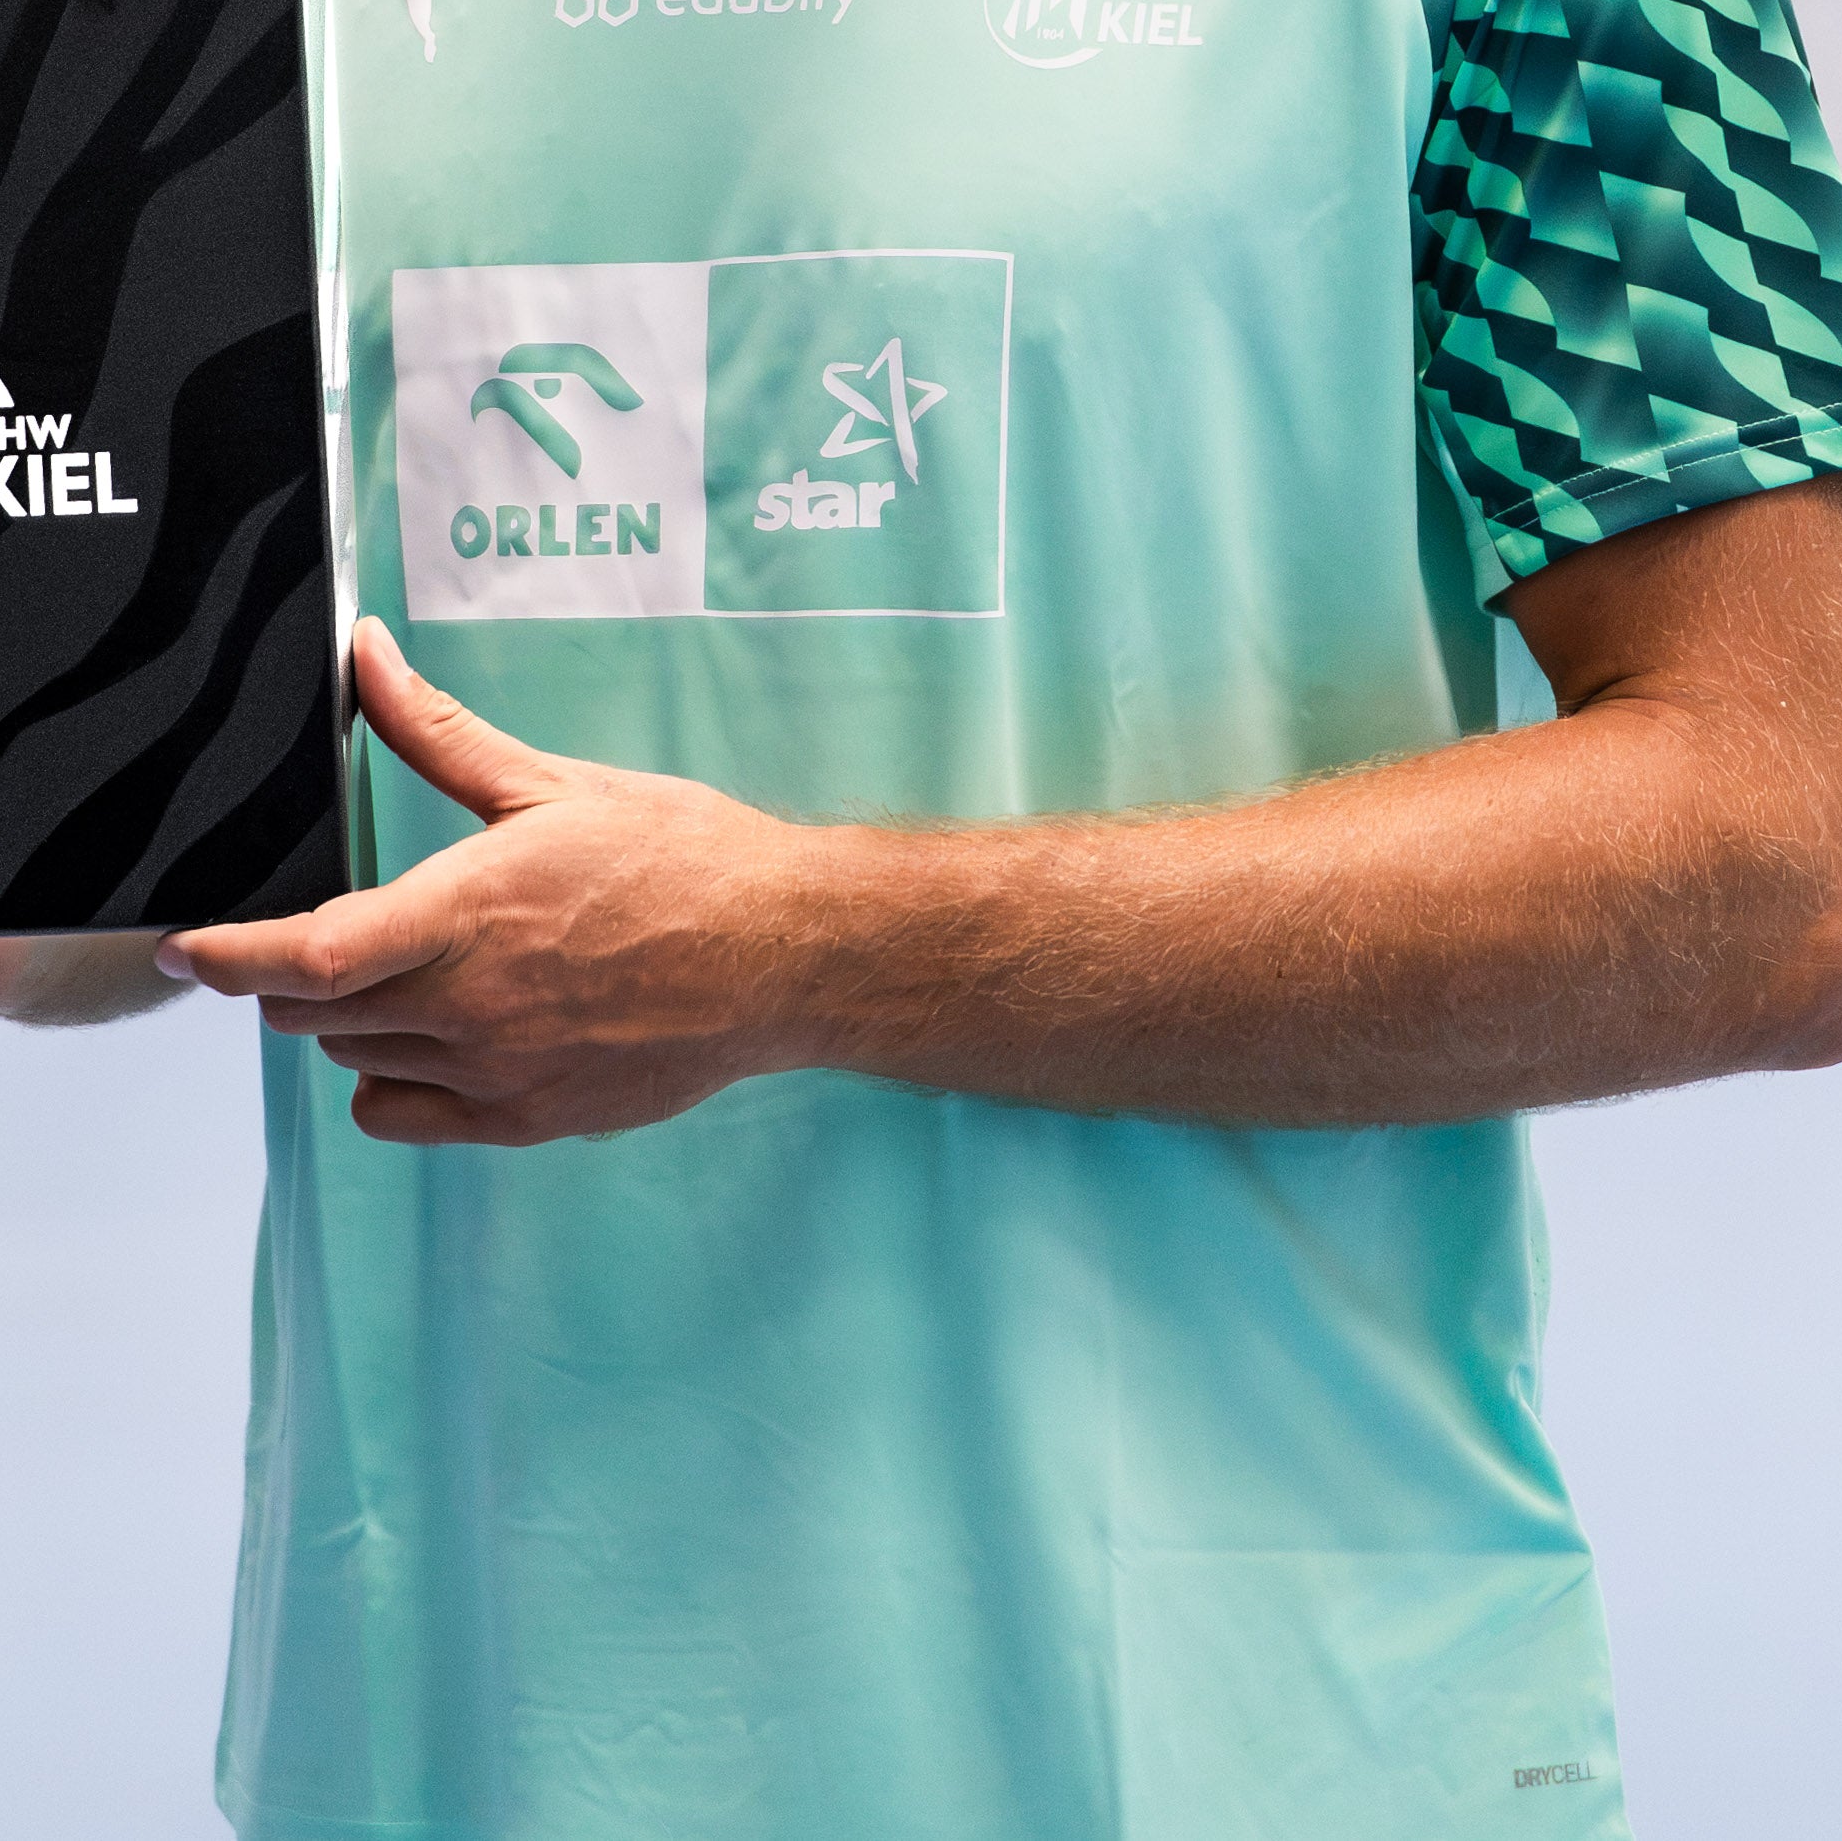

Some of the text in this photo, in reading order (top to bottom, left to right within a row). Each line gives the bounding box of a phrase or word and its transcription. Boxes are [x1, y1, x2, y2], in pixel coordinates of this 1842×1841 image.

[1036, 26, 1065, 40] 1904
[1097, 1, 1204, 46] KIEL
[754, 467, 896, 532] star
[450, 502, 661, 559] ORLEN
[1513, 1760, 1599, 1789] DRYCELL
